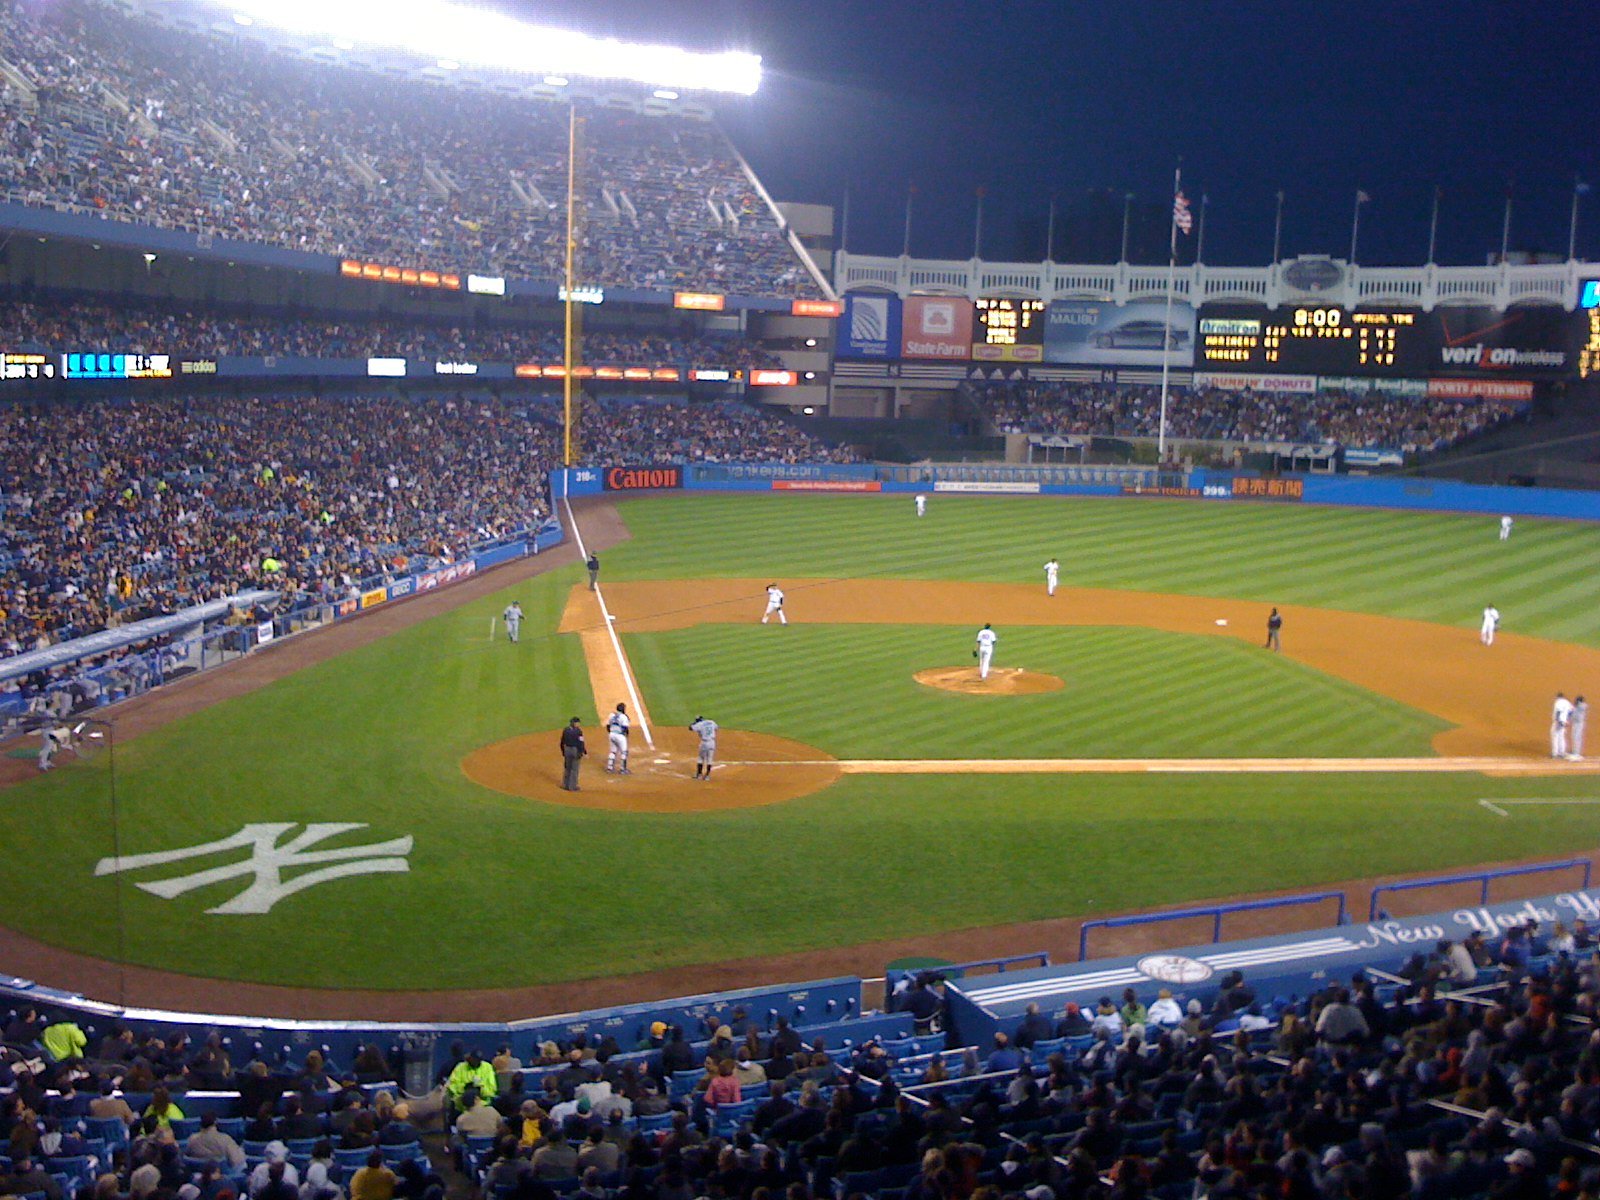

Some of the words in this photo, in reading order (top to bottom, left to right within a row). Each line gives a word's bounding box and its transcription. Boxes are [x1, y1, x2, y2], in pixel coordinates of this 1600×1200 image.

[1051, 313, 1098, 325] MALIBU
[1294, 309, 1340, 327] 8:00
[907, 342, 938, 355] State
[937, 342, 965, 356] Farm
[1442, 343, 1517, 369] verizon
[1263, 378, 1313, 389] DONUTS
[608, 467, 677, 489] Canon
[1203, 486, 1225, 496] 399
[1361, 922, 1445, 945] New
[1453, 902, 1557, 938] York
